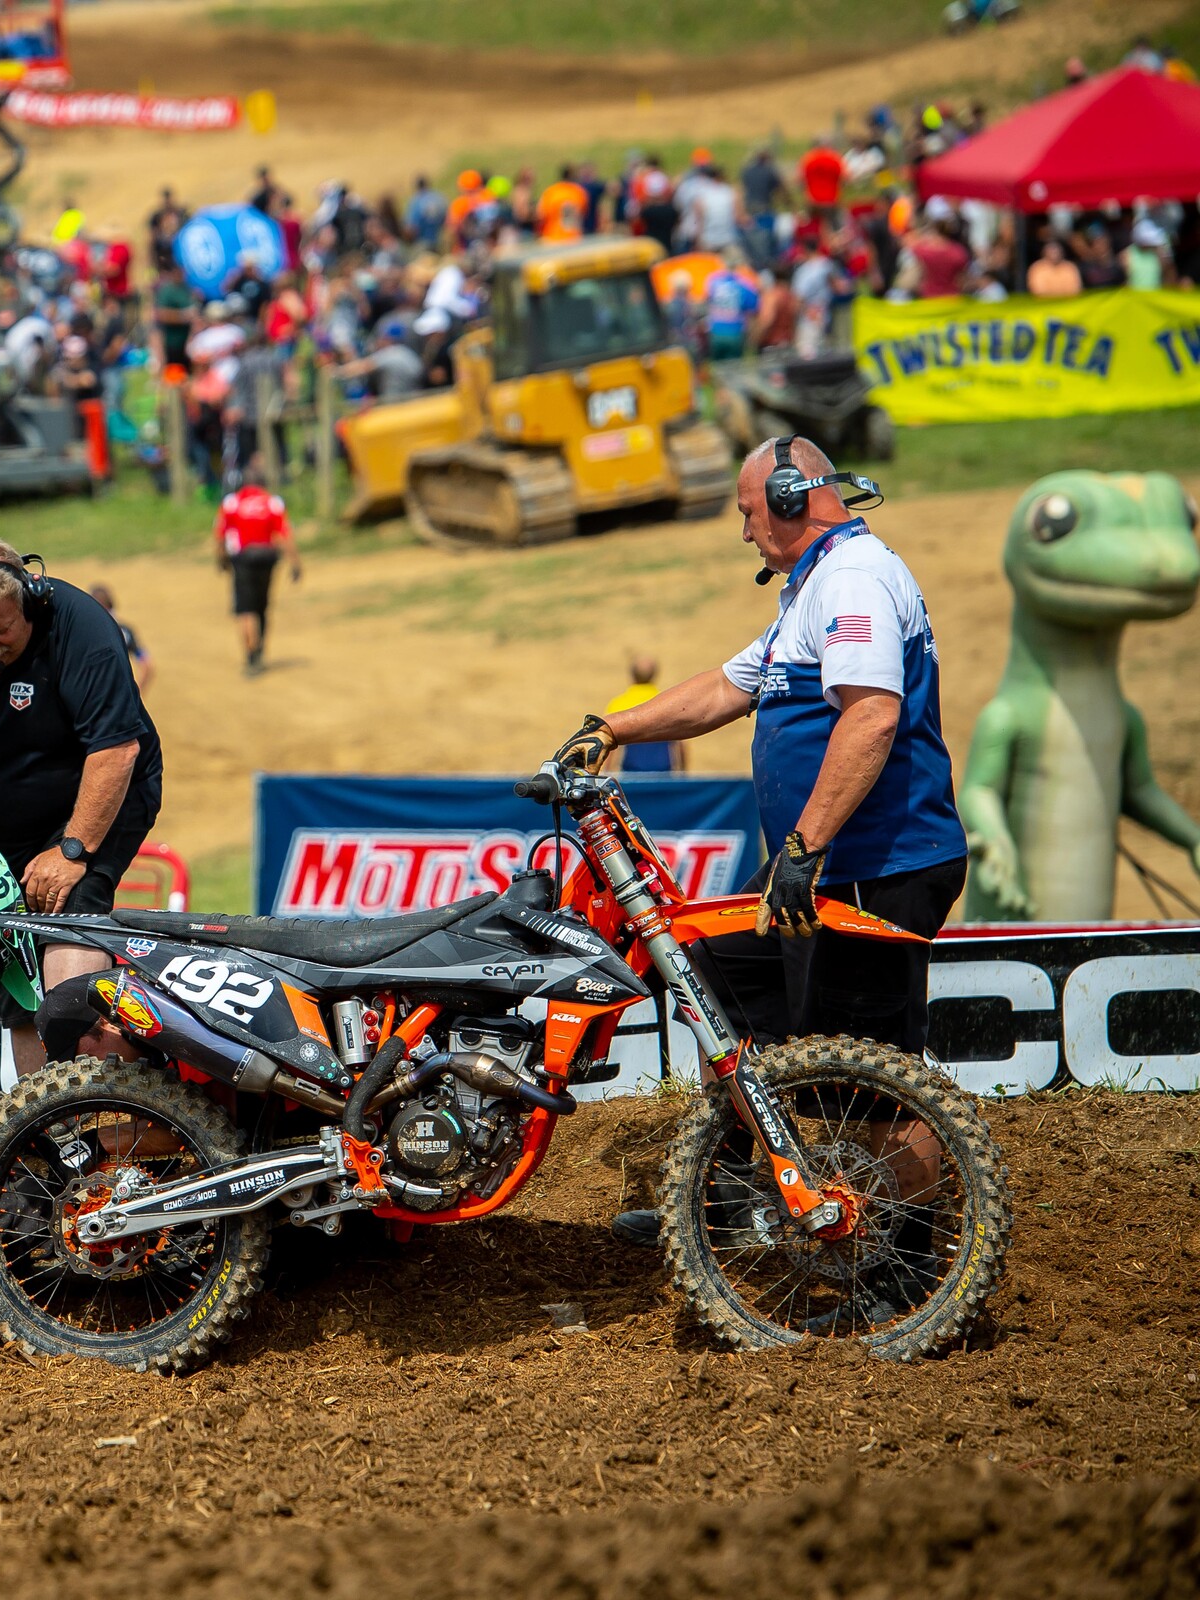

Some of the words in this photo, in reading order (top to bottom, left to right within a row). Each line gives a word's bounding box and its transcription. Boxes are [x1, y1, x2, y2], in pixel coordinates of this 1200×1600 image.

[1043, 314, 1114, 379] TEA
[4, 920, 63, 933] DUNLOP
[567, 928, 591, 943] RIDES
[563, 935, 604, 956] UNLIMITED
[158, 952, 275, 1025] 192
[550, 1012, 582, 1024] KTM
[403, 1140, 450, 1150] HINSON
[229, 1169, 285, 1193] HINSON
[954, 1222, 986, 1301] DUNLOP
[187, 1258, 232, 1331] DUNLOP
